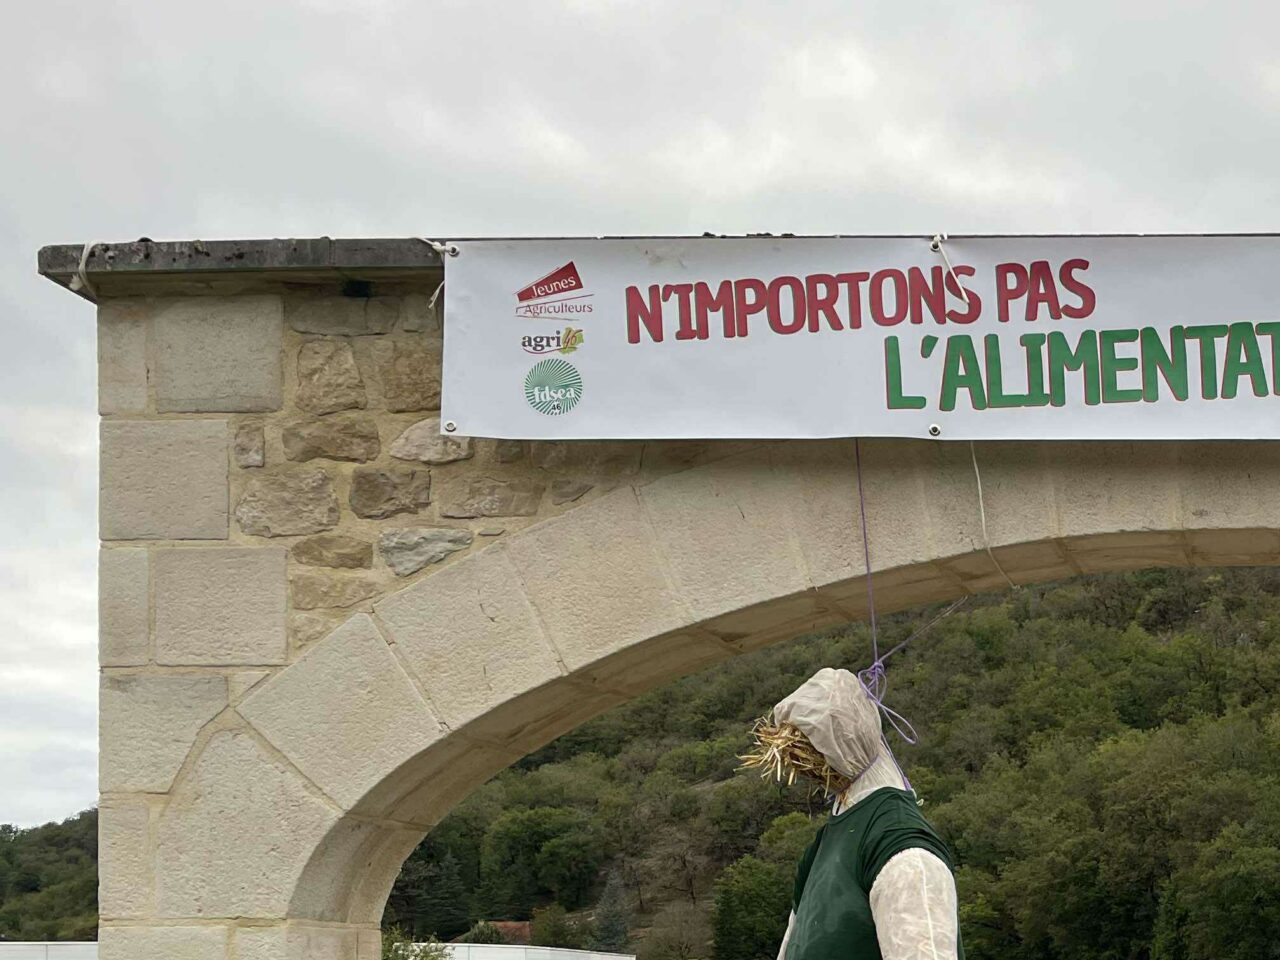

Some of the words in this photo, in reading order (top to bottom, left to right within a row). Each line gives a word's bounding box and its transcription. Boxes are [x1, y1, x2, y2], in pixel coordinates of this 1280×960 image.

[531, 275, 577, 299] Jeunes
[523, 302, 594, 317] Agriculteurs
[626, 264, 984, 345] N'IMPORTONS
[998, 259, 1098, 323] PAS
[532, 385, 577, 403] fdsea
[550, 403, 562, 412] 46
